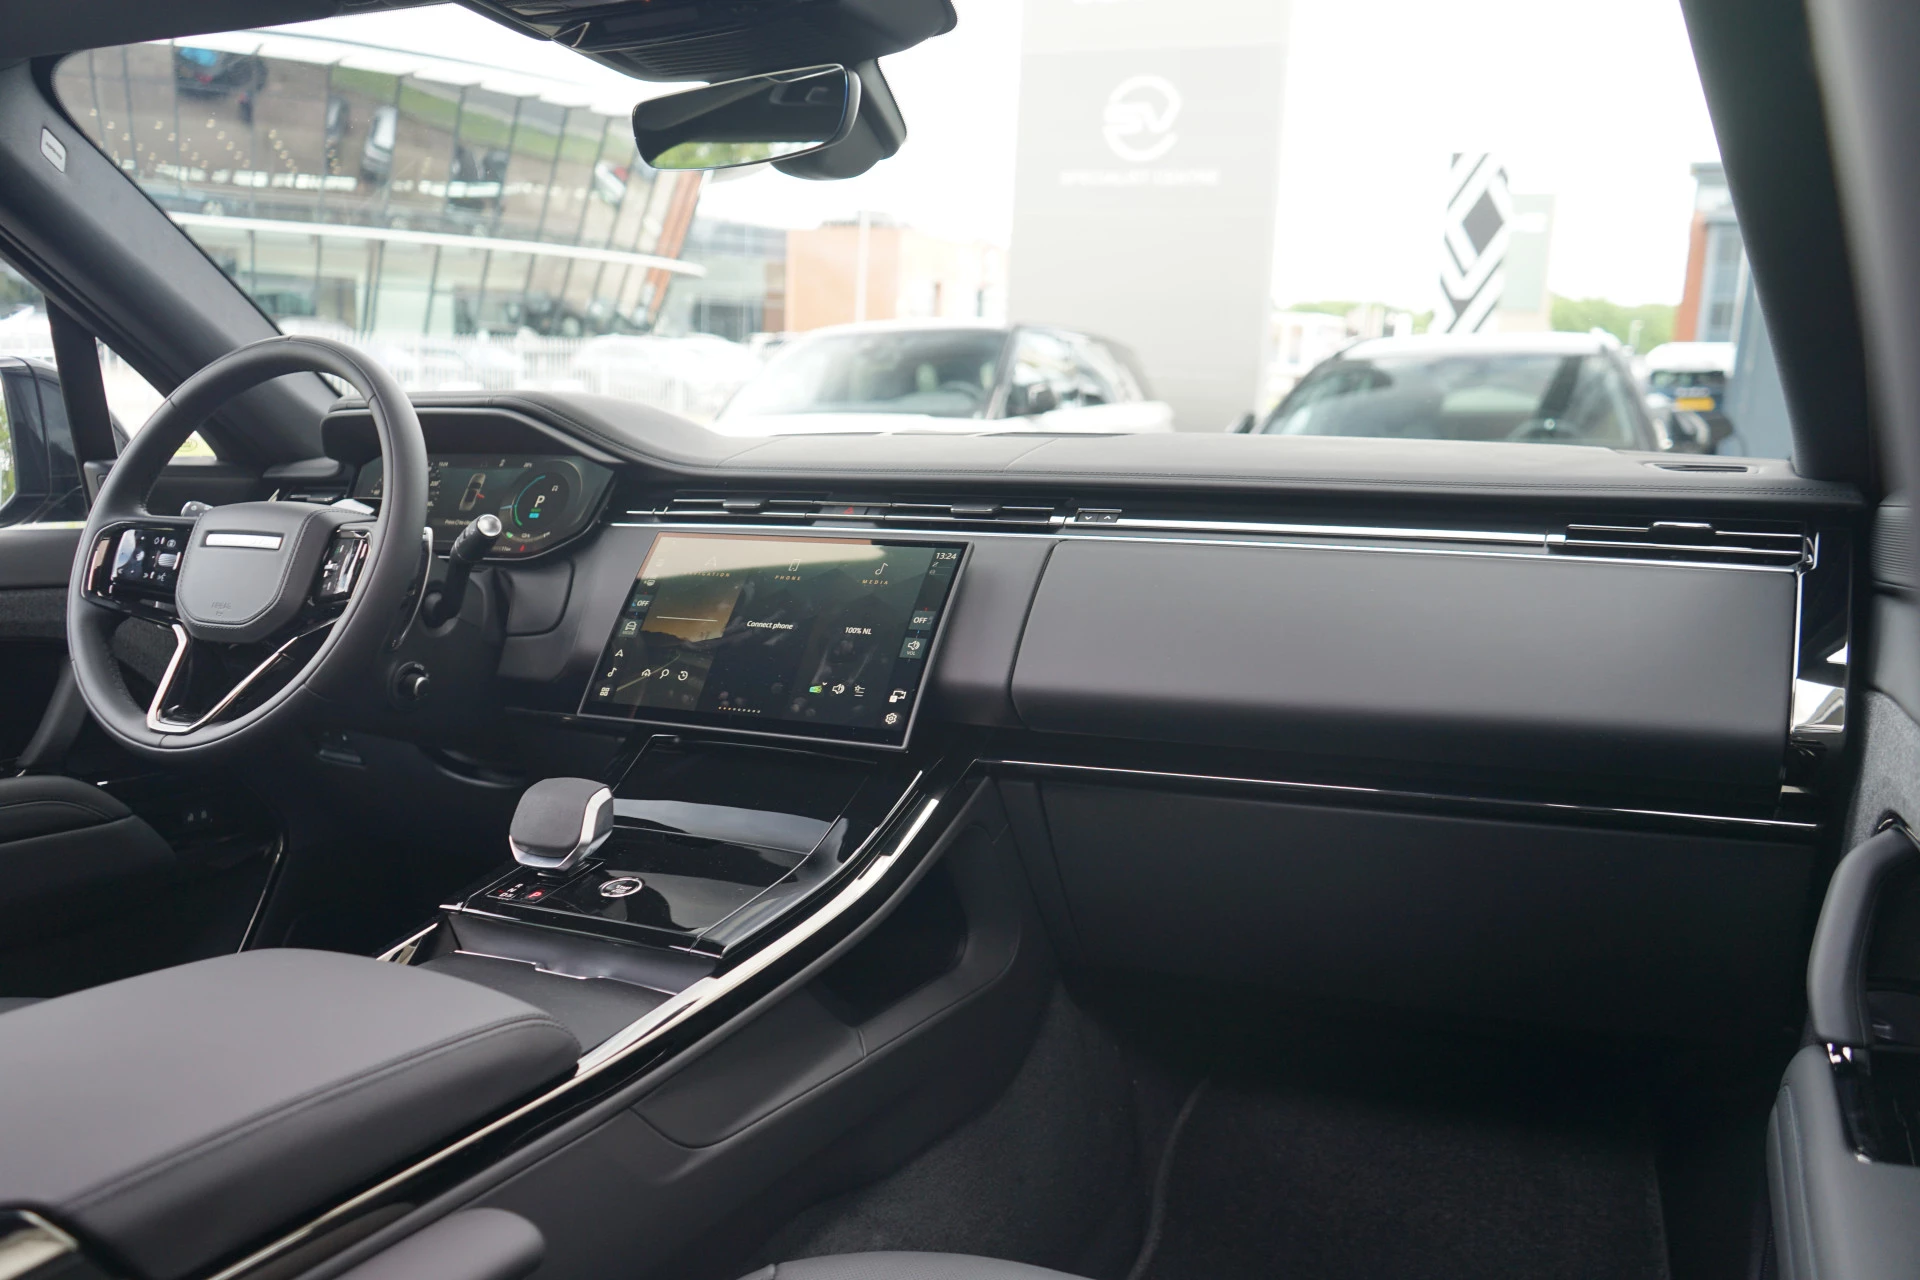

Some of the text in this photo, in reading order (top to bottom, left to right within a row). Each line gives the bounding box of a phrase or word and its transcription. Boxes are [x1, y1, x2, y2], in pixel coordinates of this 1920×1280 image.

[534, 495, 546, 508] P
[935, 552, 957, 560] 13:24
[913, 616, 928, 624] OFF
[746, 620, 794, 630] Connect phone
[845, 626, 873, 635] 100% NL
